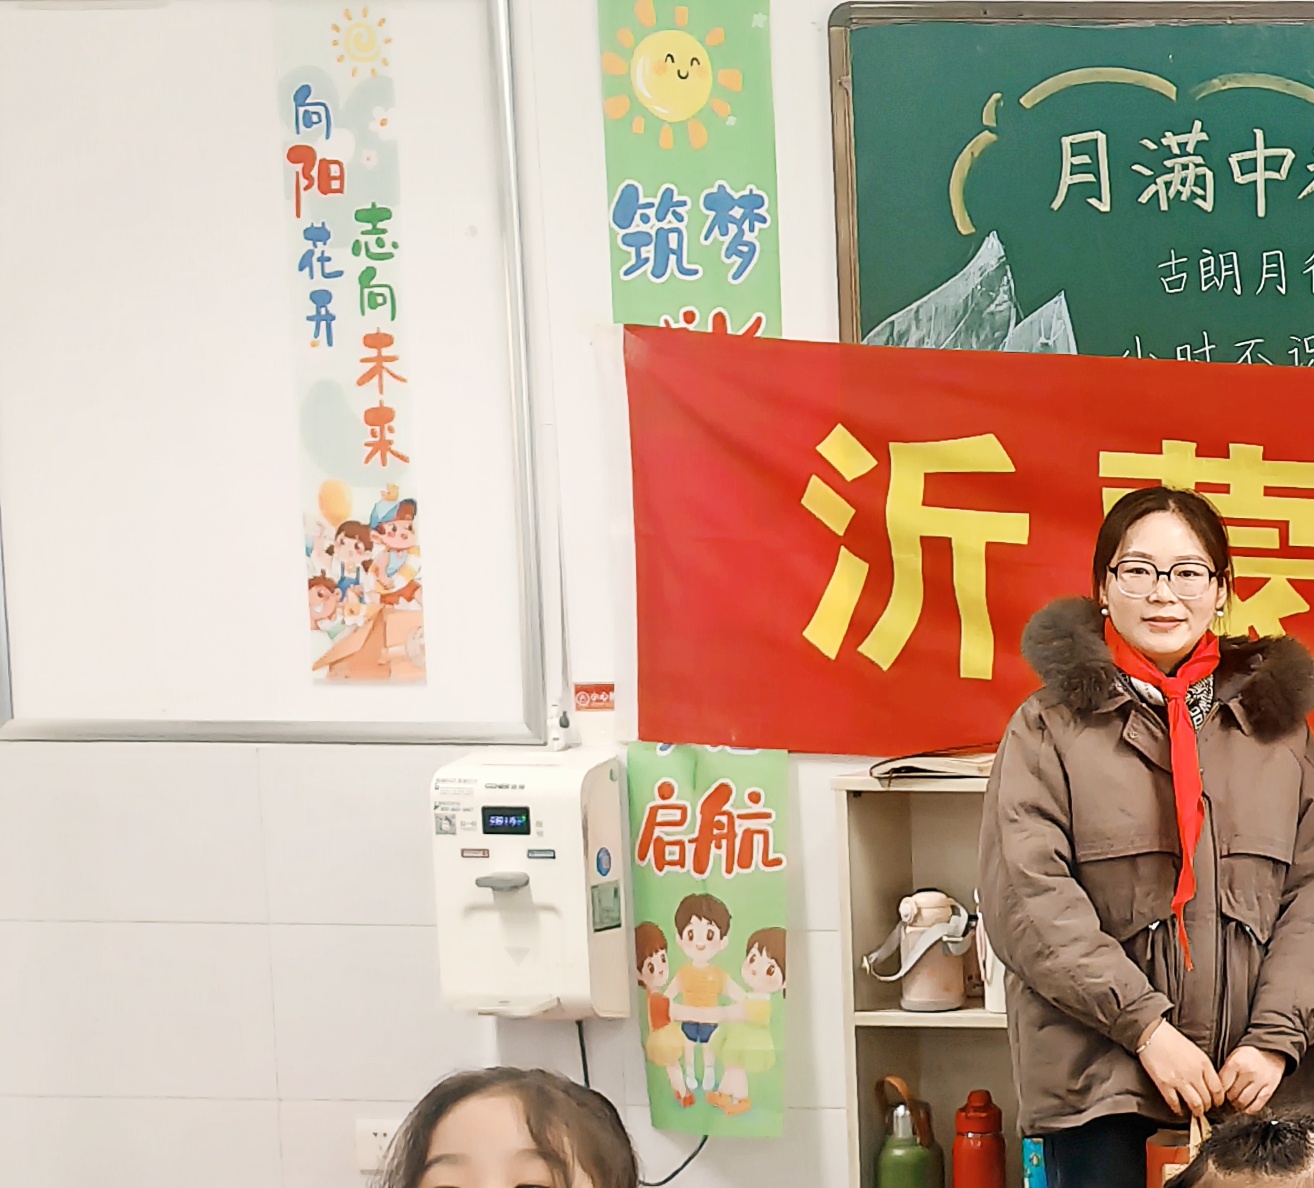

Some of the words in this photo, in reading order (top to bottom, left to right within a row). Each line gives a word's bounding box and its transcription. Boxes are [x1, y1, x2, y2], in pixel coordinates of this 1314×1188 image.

[287, 84, 346, 348] 向阳花开
[612, 183, 768, 281] 筑梦
[351, 202, 411, 467] 志向未来
[637, 781, 784, 875] 启航
